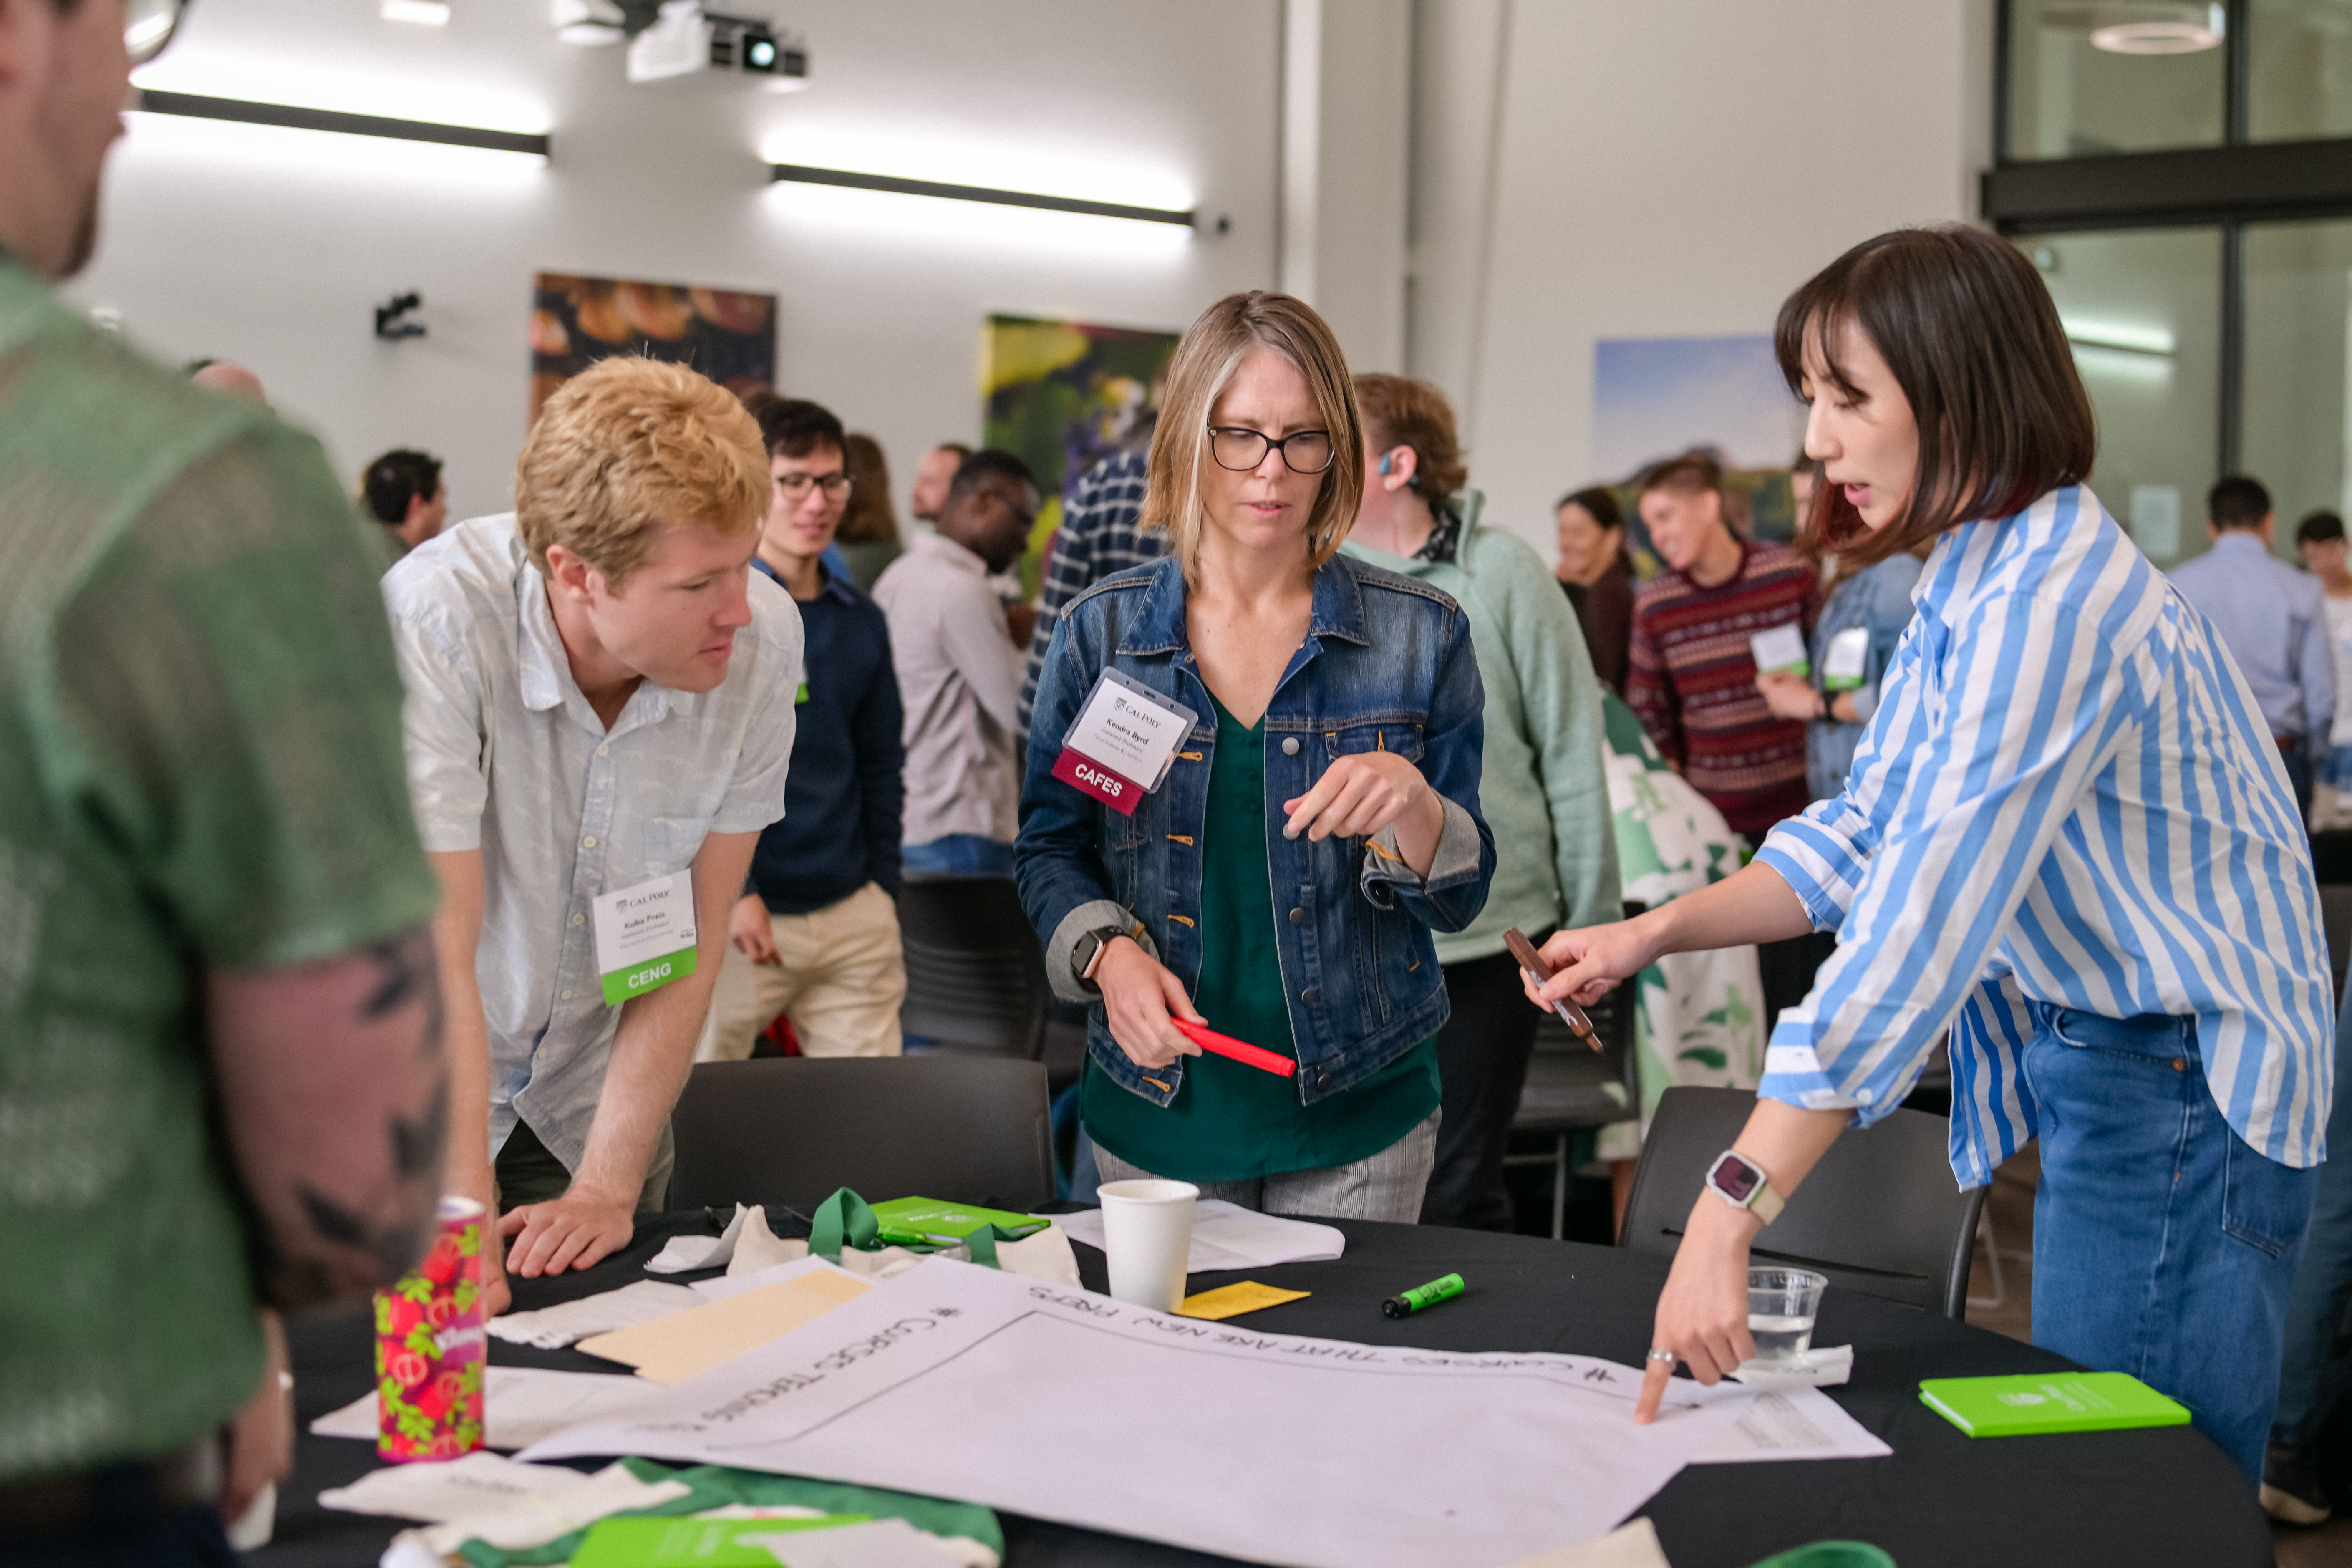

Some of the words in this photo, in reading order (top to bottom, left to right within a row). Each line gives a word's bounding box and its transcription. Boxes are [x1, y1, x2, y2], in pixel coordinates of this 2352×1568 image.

[1126, 706, 1140, 718] CAL
[1142, 713, 1161, 728] POLY
[1107, 718, 1130, 736] Kendra
[1132, 732, 1149, 745] Byrd
[1075, 764, 1122, 797] CAFES
[630, 897, 648, 908] CAL
[649, 890, 669, 902] POLY
[625, 919, 645, 930] Kuba
[628, 963, 672, 989] CENG
[1132, 1317, 1208, 1336] NEW
[1213, 1333, 1276, 1352] ARE
[1280, 1344, 1385, 1362] THAT
